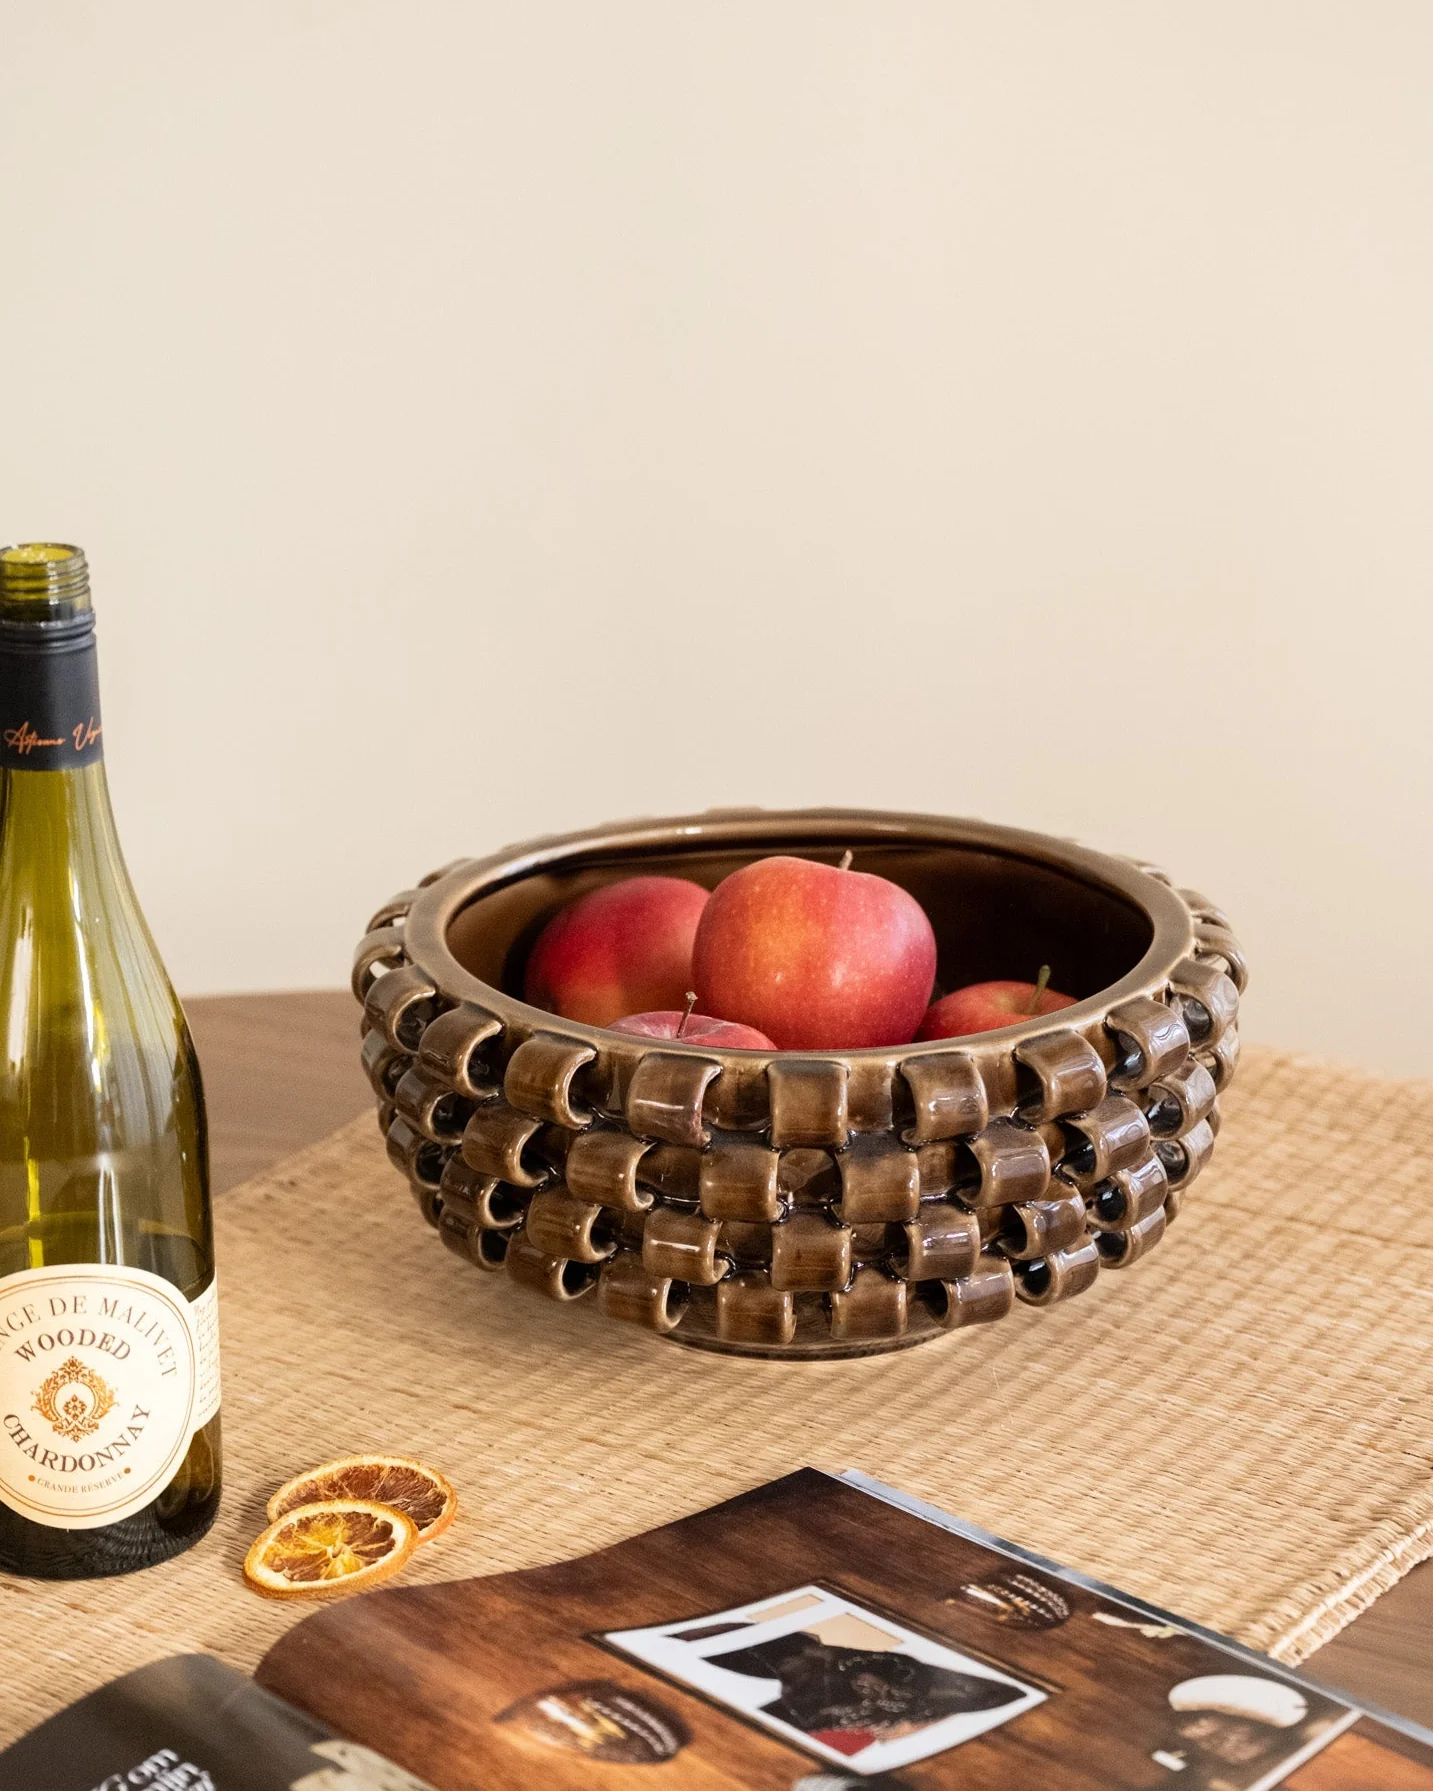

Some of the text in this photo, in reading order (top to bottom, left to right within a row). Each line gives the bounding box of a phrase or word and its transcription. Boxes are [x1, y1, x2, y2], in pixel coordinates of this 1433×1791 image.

[13, 1328, 131, 1363] WOODED
[49, 1294, 88, 1317] DE
[98, 1297, 178, 1376] MALIVET
[3, 1404, 151, 1473] CHARDONNAY
[36, 1477, 79, 1494] GRANDE
